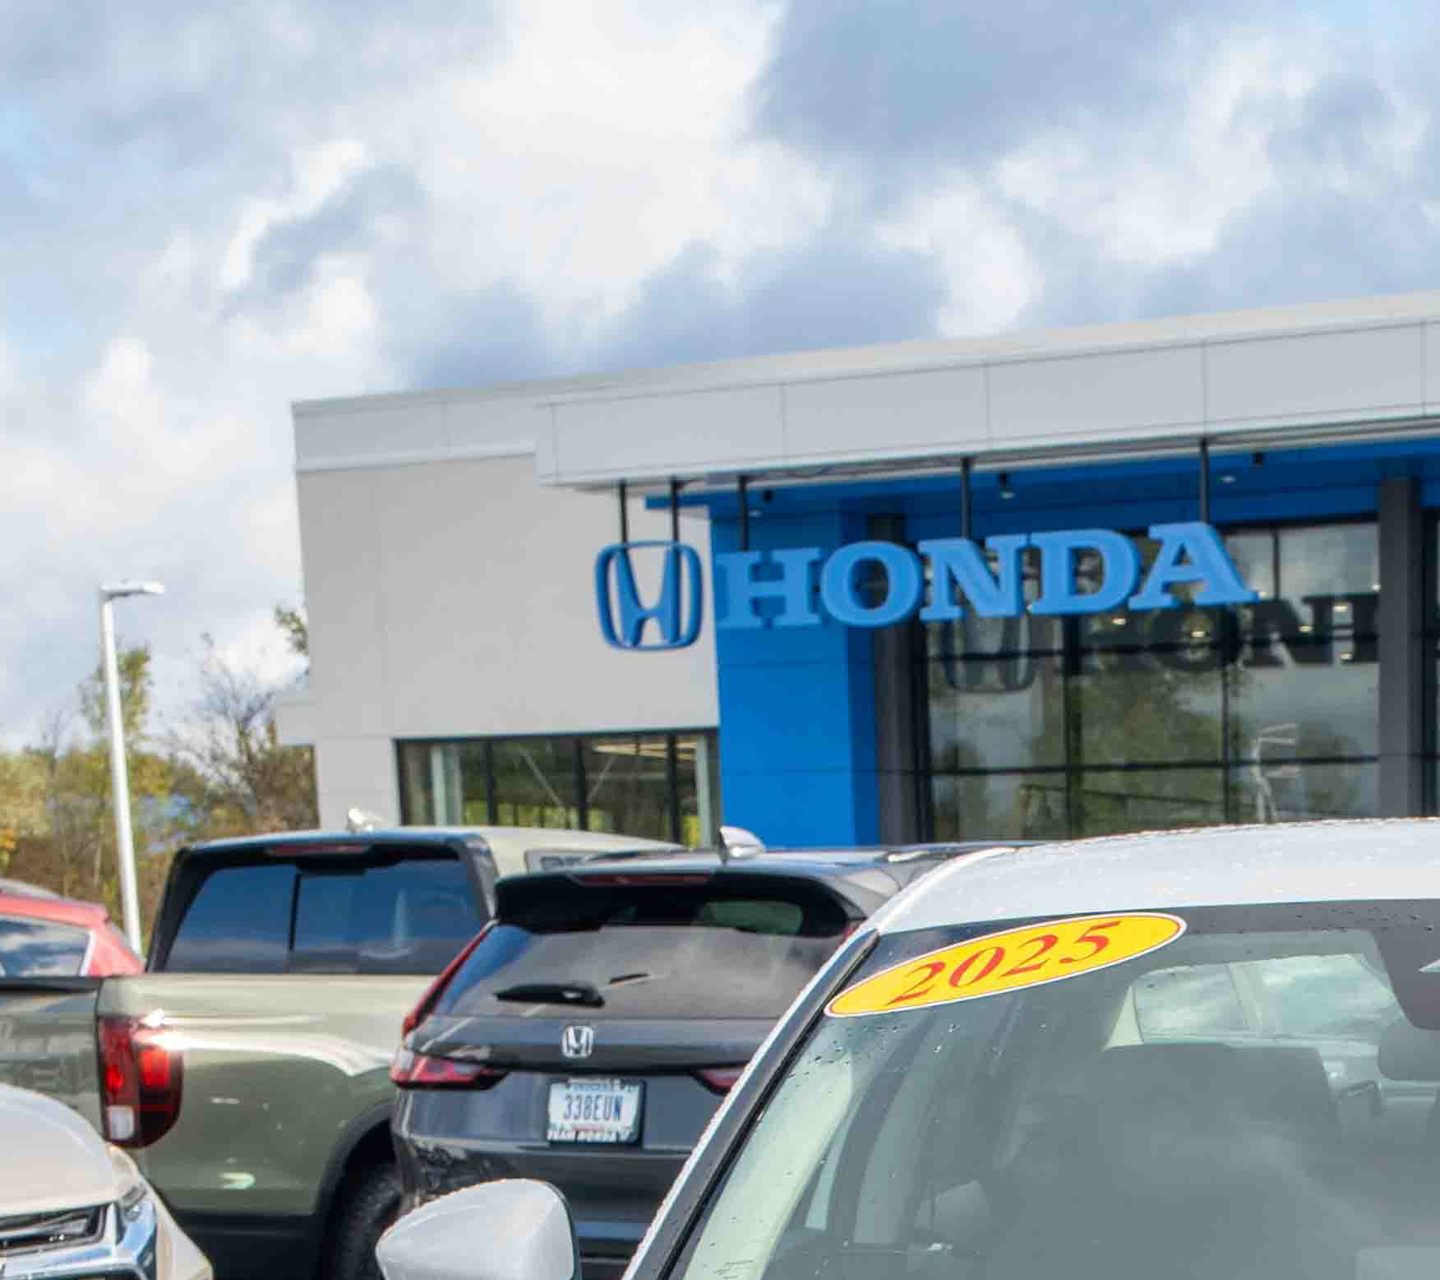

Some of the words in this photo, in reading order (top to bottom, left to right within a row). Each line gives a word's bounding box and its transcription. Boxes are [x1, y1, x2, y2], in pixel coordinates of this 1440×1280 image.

[712, 521, 1259, 628] HONDA
[885, 919, 1122, 1007] 2025
[562, 1093, 624, 1121] 338EUN
